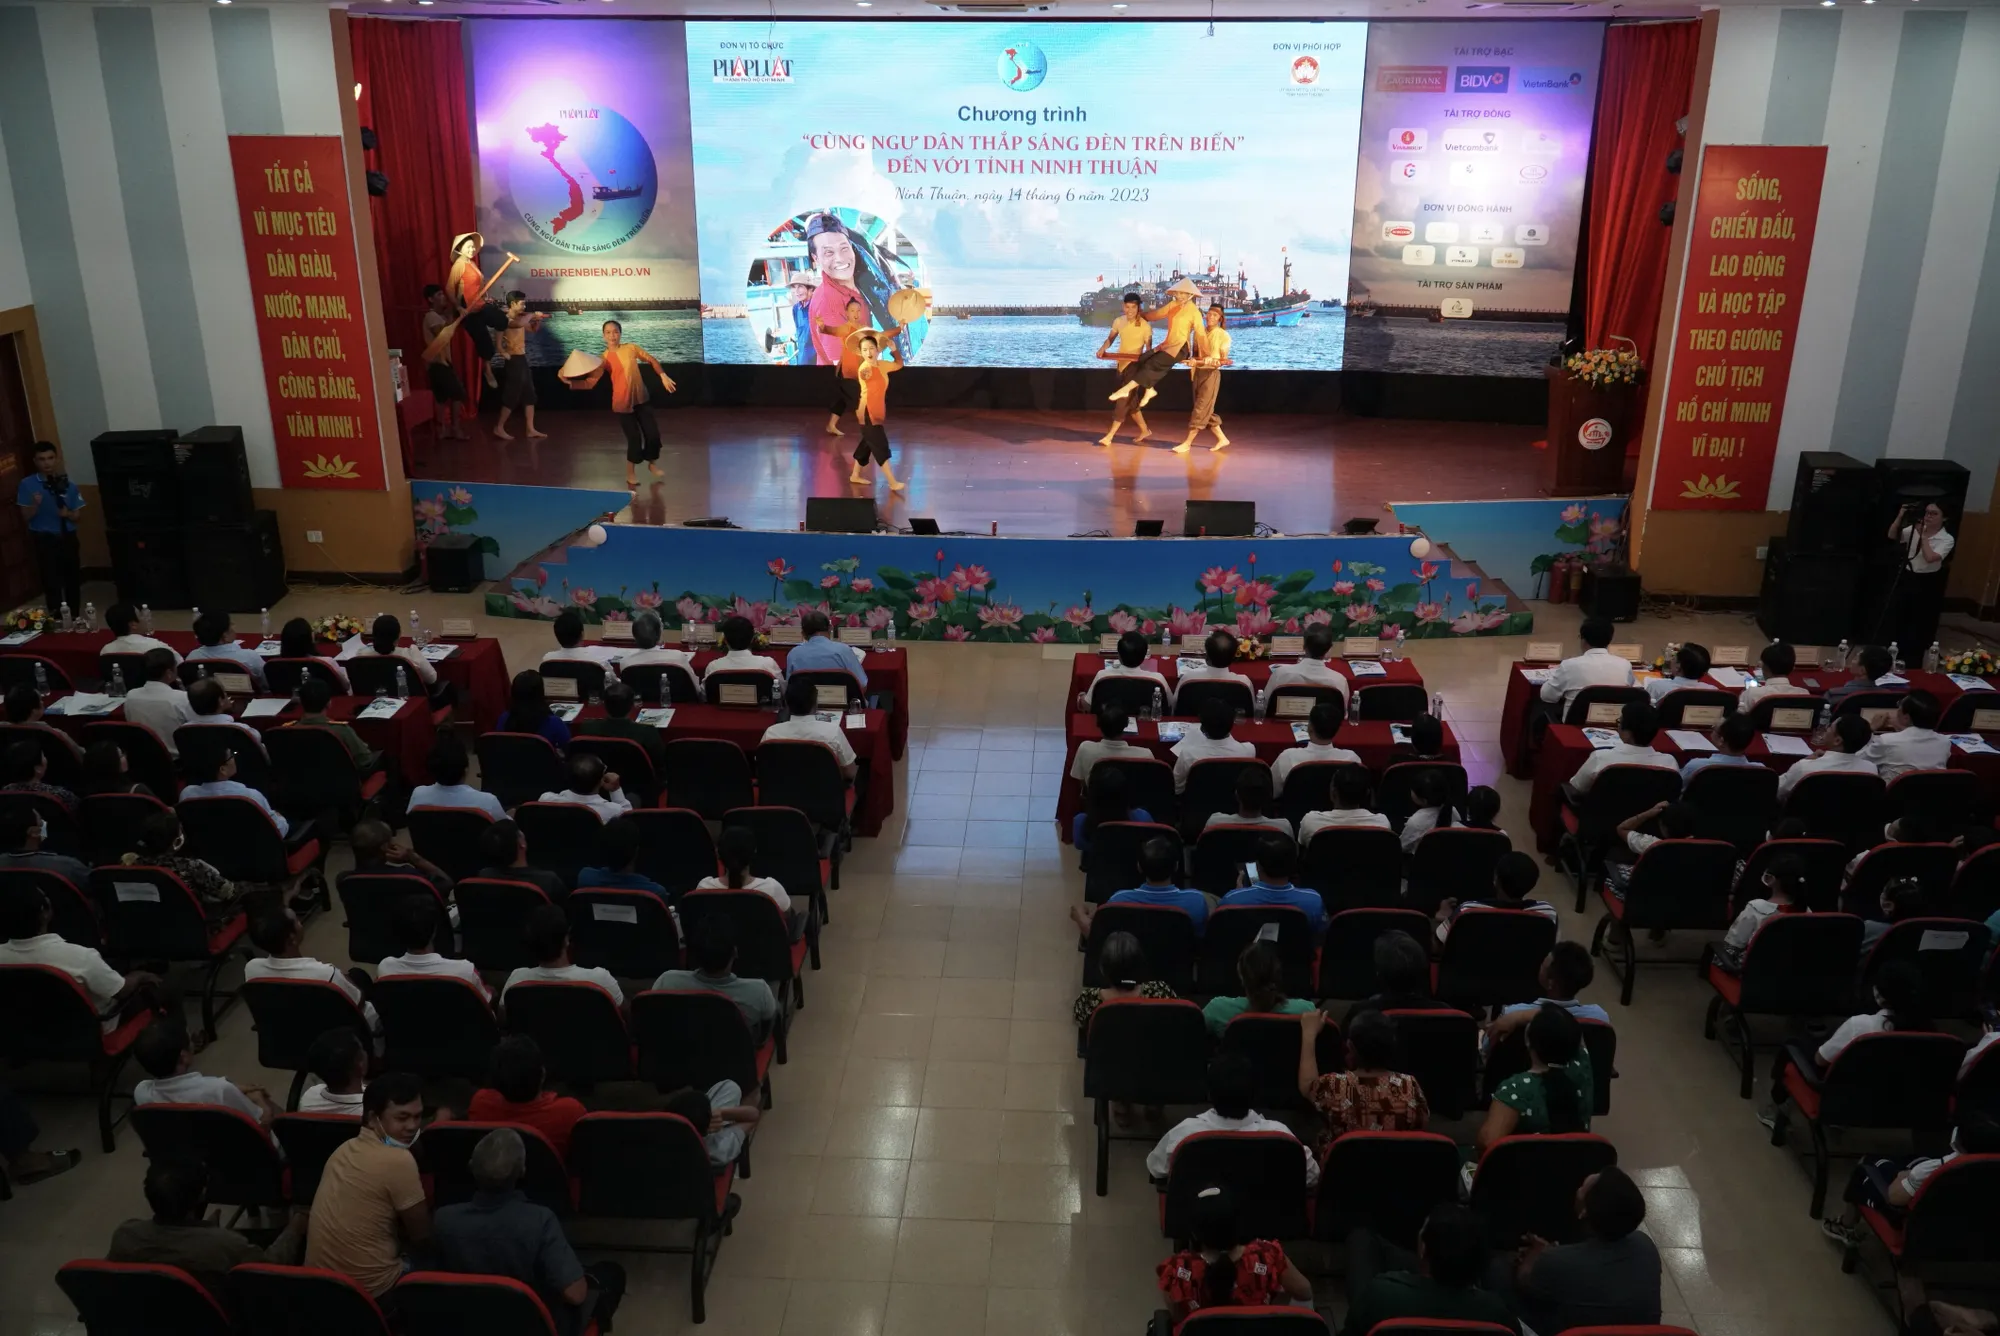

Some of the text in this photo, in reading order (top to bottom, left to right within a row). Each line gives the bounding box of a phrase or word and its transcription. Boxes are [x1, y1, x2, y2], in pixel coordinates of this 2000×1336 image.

[1460, 75, 1493, 88] BIDV
[1523, 79, 1571, 89] VietinBank
[957, 104, 1088, 126] Chương trình
[871, 134, 920, 151] NGƯ
[923, 132, 965, 151] DÂN
[968, 129, 1023, 151] THẮP
[1027, 132, 1081, 151] SÁNG
[1085, 132, 1127, 152] ĐÈN
[1131, 131, 1184, 152] TRÊN
[1445, 143, 1499, 151] Vietcombank
[264, 158, 314, 194] TẤT CẢ
[887, 152, 1158, 179] ĐẾN VỚI TỈNH NINH THUẬN
[894, 186, 924, 202] Ninh
[973, 189, 1004, 205] ngày
[1007, 187, 1023, 202] 14
[1025, 187, 1062, 204] tháng
[1066, 187, 1076, 202] 6
[1078, 189, 1106, 202] năm
[1109, 187, 1150, 203] 2023
[1735, 170, 1783, 204] SỐNG,
[253, 206, 337, 241] VÌ MỤC TIÊU
[1710, 208, 1797, 242] CHIẾN ĐẤU,
[266, 249, 338, 281] DÂN GIÀU,
[530, 267, 652, 279] DENTRENBIEN.PLO.VN
[1709, 250, 1786, 282] LAO ĐỘNG
[264, 288, 352, 324] NƯỚC MẠNH,
[1698, 287, 1786, 320] VÀ HỌC TẬP
[281, 328, 347, 362] DÂN CHỦ,
[1688, 327, 1784, 352] THEO GƯƠNG
[278, 370, 317, 399] CÔNG
[319, 368, 361, 402] BẰNG,
[1695, 358, 1765, 391] CHỦ TỊCH
[1676, 394, 1772, 423] HỒ CHÍ MINH
[287, 409, 316, 439] VĂN
[317, 415, 354, 439] MINH
[1691, 431, 1708, 458] VĨ
[1709, 437, 1737, 461] ĐẠI
